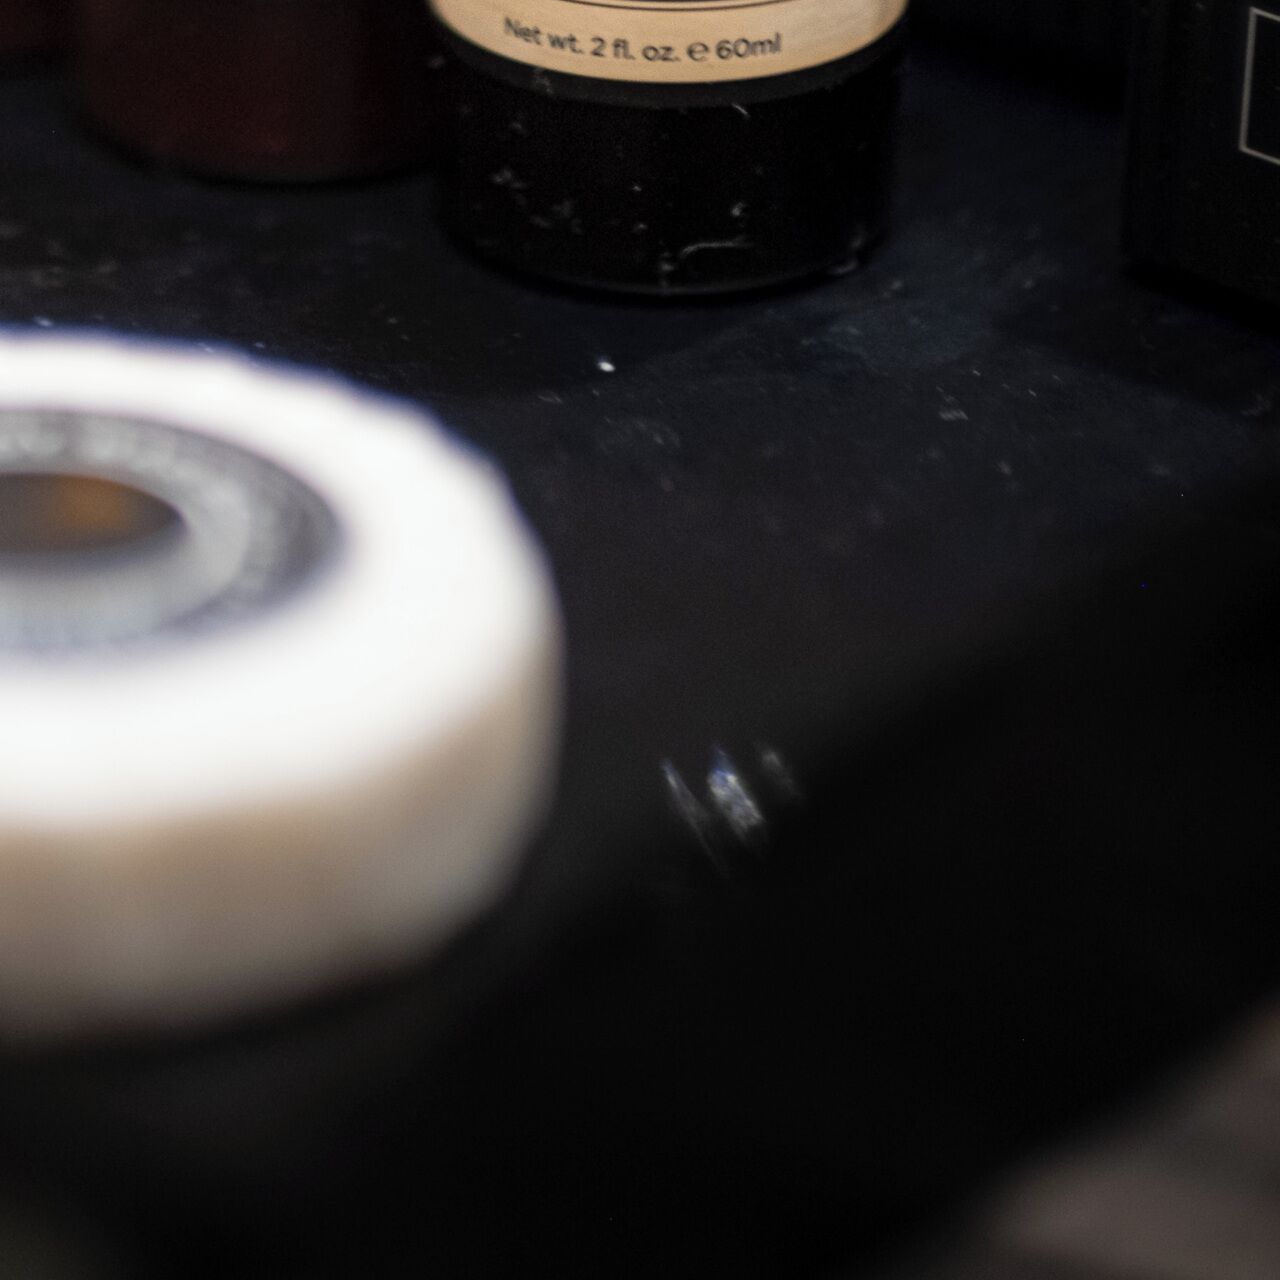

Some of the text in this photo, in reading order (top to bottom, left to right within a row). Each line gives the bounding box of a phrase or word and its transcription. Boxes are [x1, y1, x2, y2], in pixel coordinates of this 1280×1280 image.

[504, 16, 542, 46] Net
[547, 34, 584, 55] wt.
[590, 36, 606, 58] 2
[611, 37, 636, 61] fl.
[641, 44, 680, 63] oz.
[715, 32, 783, 60] 60ml
